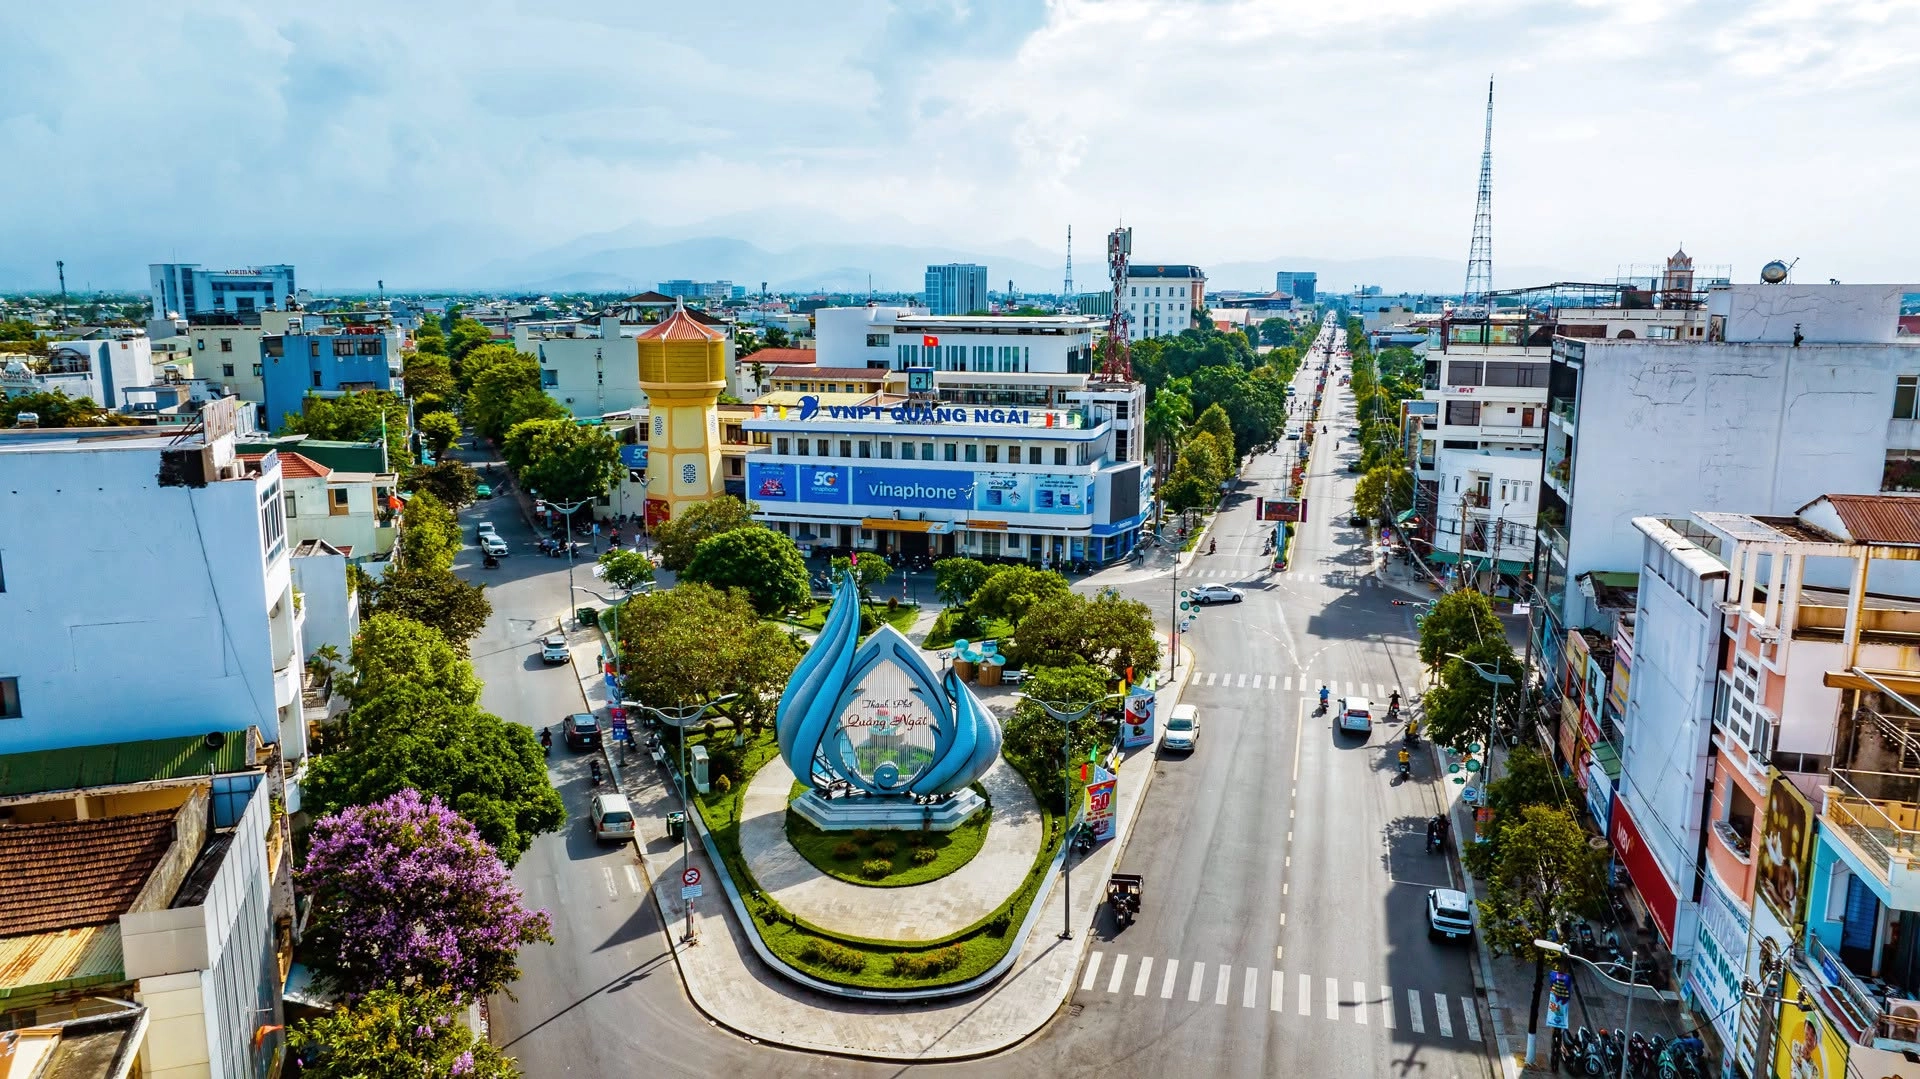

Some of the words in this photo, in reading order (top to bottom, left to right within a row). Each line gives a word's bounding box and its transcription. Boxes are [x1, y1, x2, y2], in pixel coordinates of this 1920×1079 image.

[828, 405, 884, 420] VNPT
[890, 402, 967, 423] QUẢNG
[974, 405, 1030, 424] NGÃI
[868, 481, 957, 499] vinaphone
[1134, 699, 1146, 710] 30
[846, 714, 886, 731] Quảng
[1090, 792, 1110, 811] 50
[1698, 922, 1717, 967] LONG
[1718, 952, 1740, 1001] NGỌC
